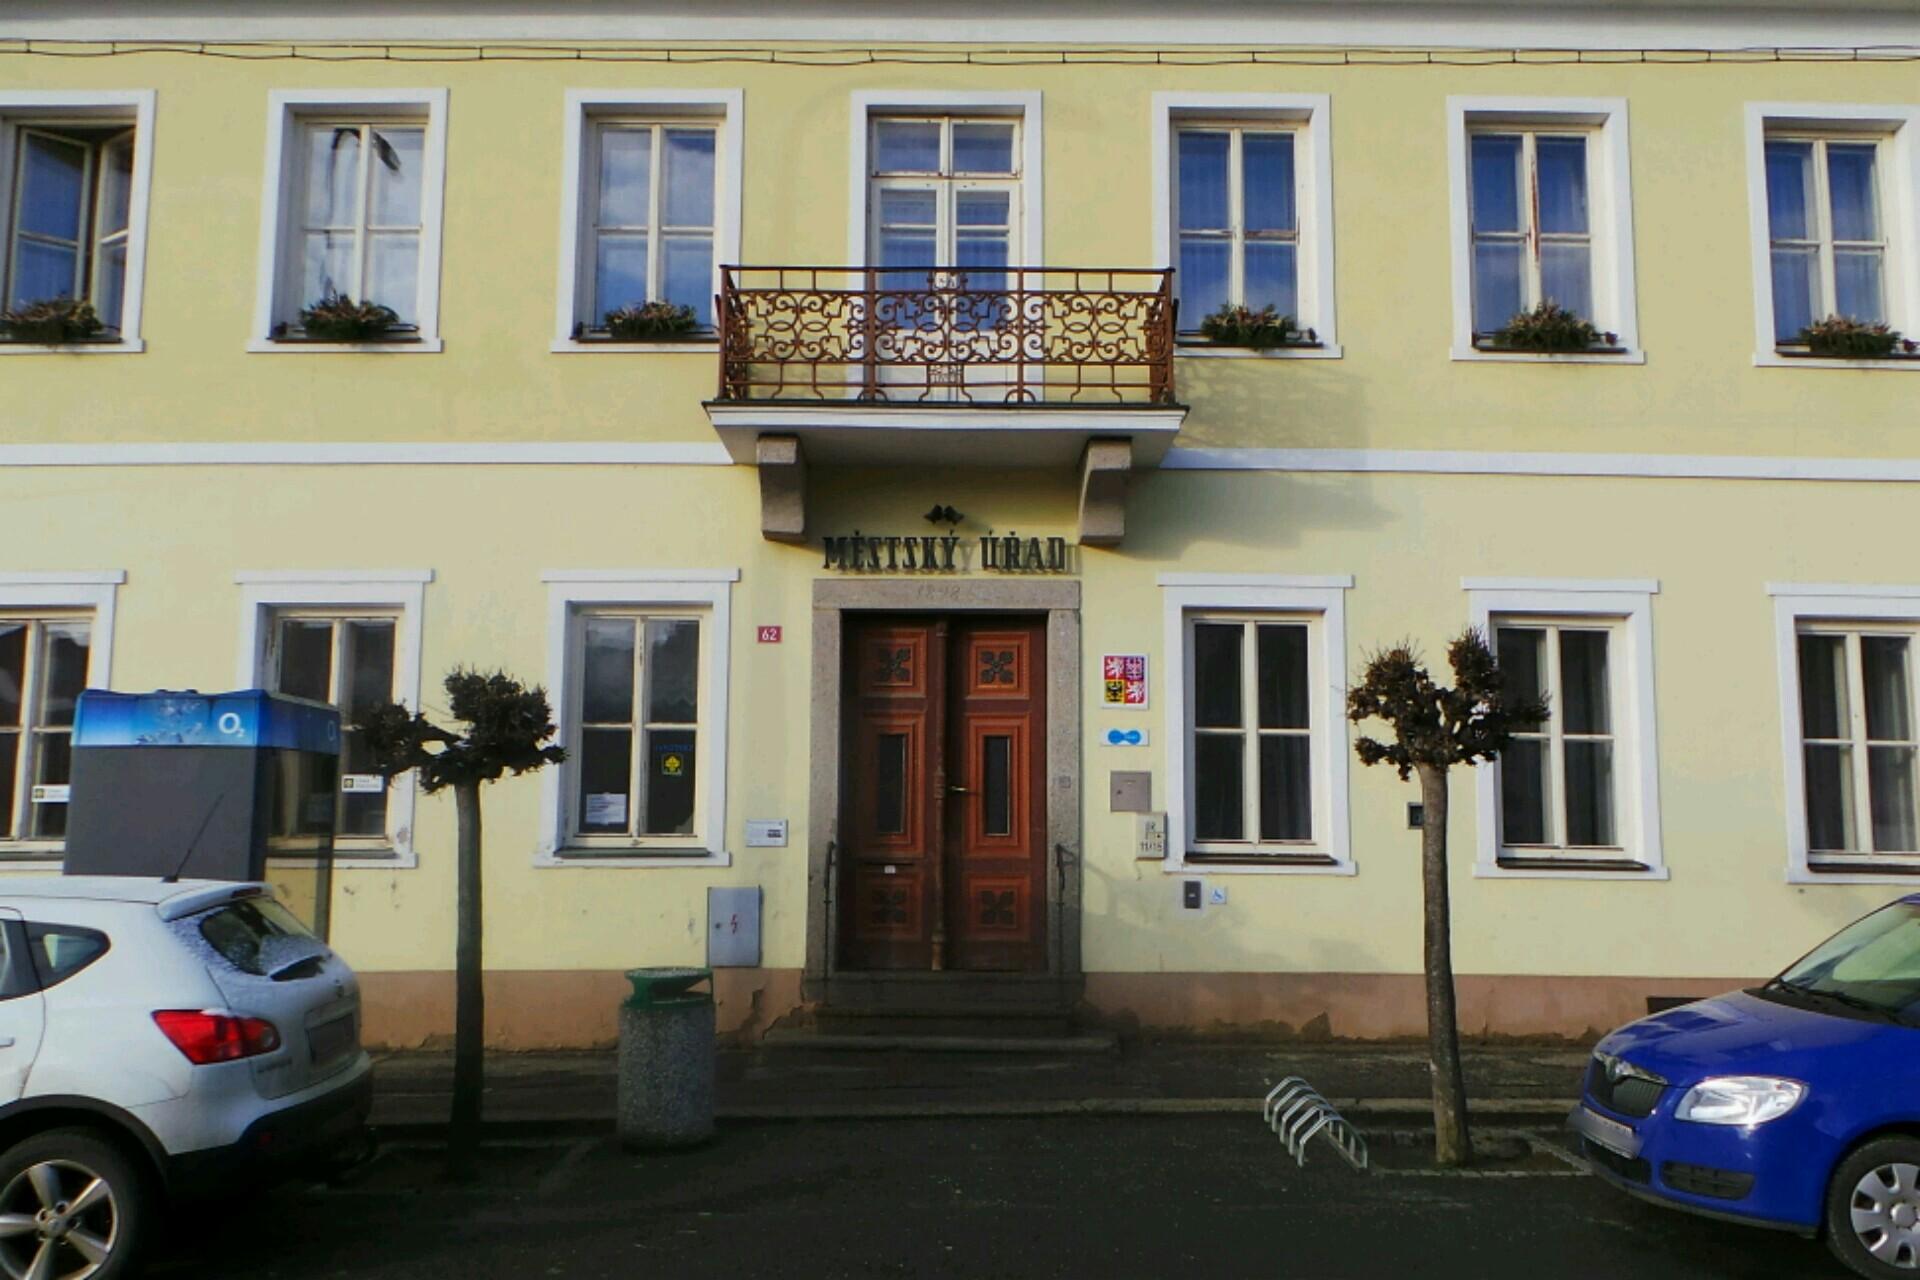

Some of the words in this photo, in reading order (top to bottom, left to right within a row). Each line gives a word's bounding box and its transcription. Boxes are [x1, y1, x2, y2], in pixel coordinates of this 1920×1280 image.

[822, 529, 960, 569] MĚSTSKÝ
[979, 529, 1066, 570] ÚŘAD
[762, 628, 777, 641] 62
